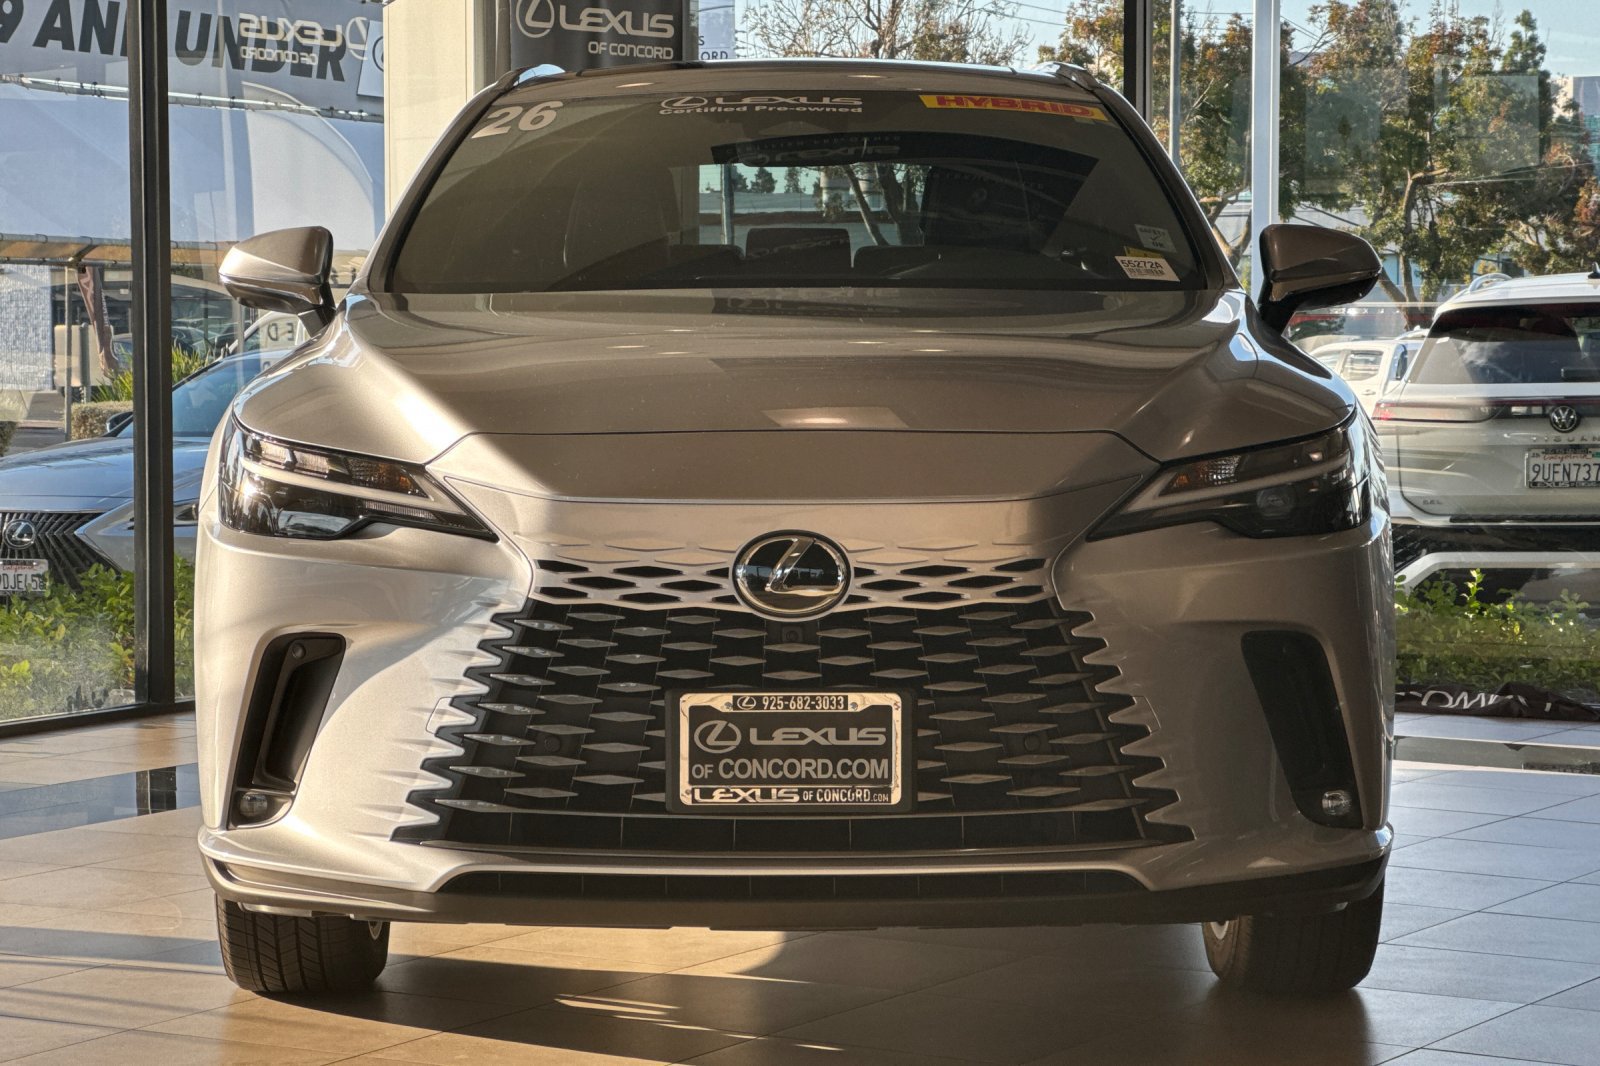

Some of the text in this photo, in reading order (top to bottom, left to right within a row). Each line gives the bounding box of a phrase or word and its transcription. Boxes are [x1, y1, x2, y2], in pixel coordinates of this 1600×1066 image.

[560, 5, 675, 39] LEXUS
[32, 0, 128, 57] AN
[175, 10, 346, 82] UNDER
[588, 41, 674, 60] OF CONCORD
[659, 105, 863, 115] Certified Pre-owned
[715, 96, 863, 106] LEXUS
[936, 95, 1094, 117] HYBRID
[471, 101, 564, 138] 26
[1120, 260, 1164, 269] 55272A
[1532, 463, 1600, 482] 9UFN737
[762, 696, 845, 710] 925-682-3033
[750, 727, 887, 746] LEXUS
[691, 758, 889, 779] OF CONCORD.COM
[693, 788, 800, 803] LEXUS
[802, 789, 814, 801] OF
